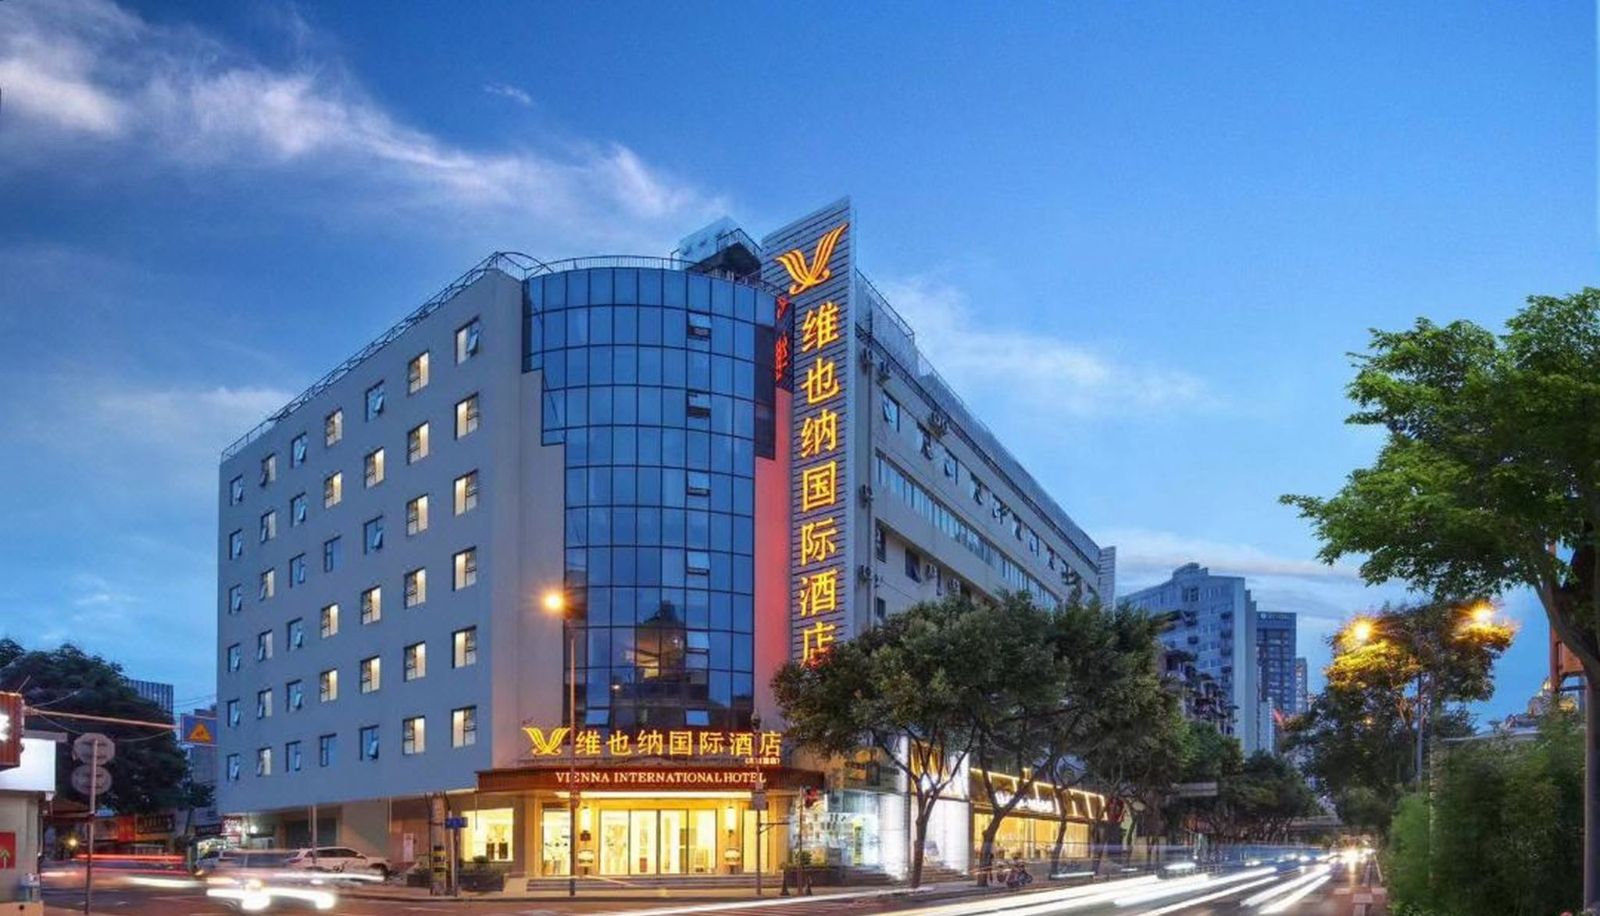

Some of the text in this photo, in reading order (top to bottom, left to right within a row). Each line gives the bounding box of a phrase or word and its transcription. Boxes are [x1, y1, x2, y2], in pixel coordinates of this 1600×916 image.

[800, 302, 840, 668] 维也纳国际酒店
[575, 729, 782, 757] 维也纳国际酒店
[555, 771, 767, 784] VIENNA INTERNATIONAL HOTEL
